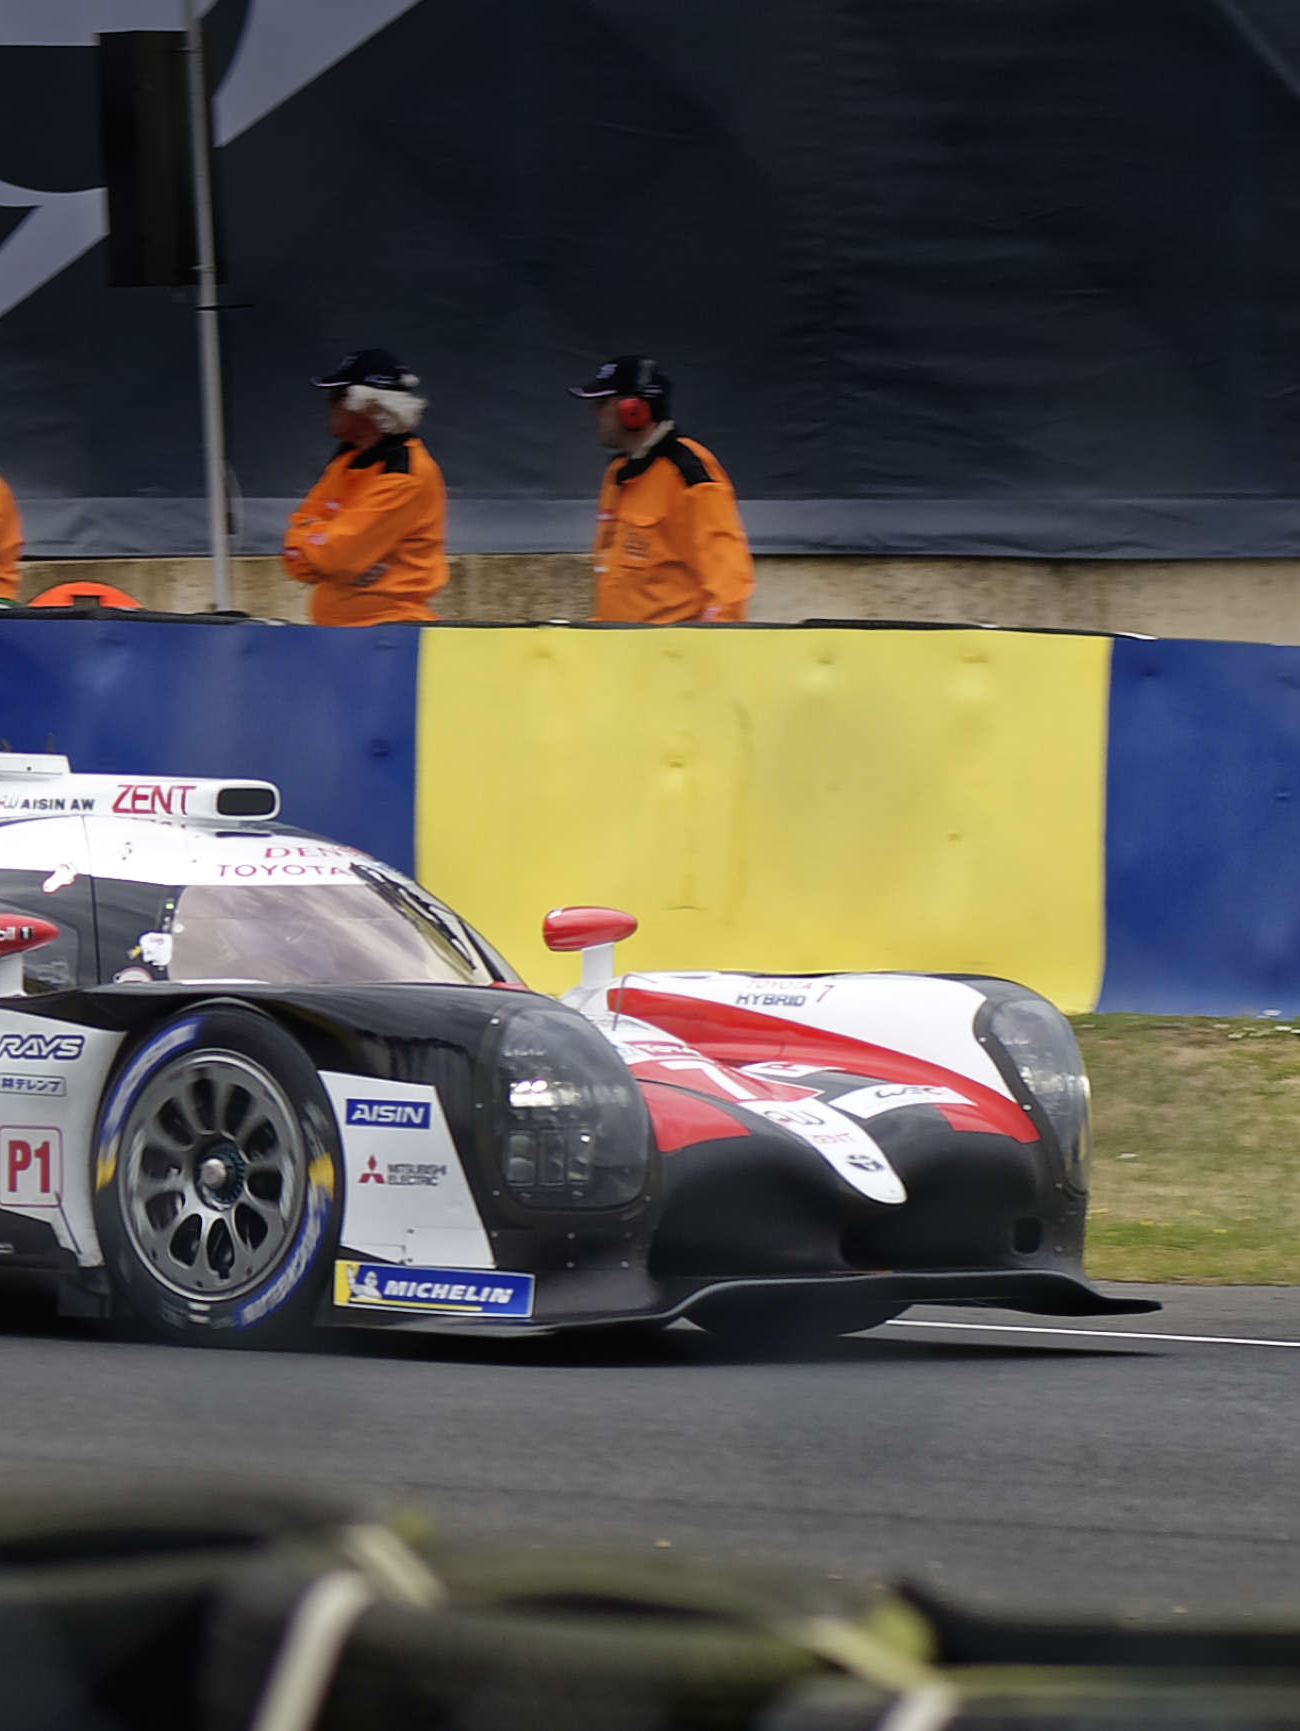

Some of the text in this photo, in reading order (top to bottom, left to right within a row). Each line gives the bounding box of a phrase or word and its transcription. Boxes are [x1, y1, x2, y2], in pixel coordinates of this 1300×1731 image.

[21, 799, 66, 811] AISIN
[70, 799, 96, 811] AW
[112, 785, 196, 815] ZENT
[217, 864, 351, 878] TOYOTA
[736, 993, 806, 1007] HYBRID
[351, 1103, 425, 1125] AISIN
[7, 1139, 51, 1194] P1
[384, 1279, 514, 1304] MICHELIN
